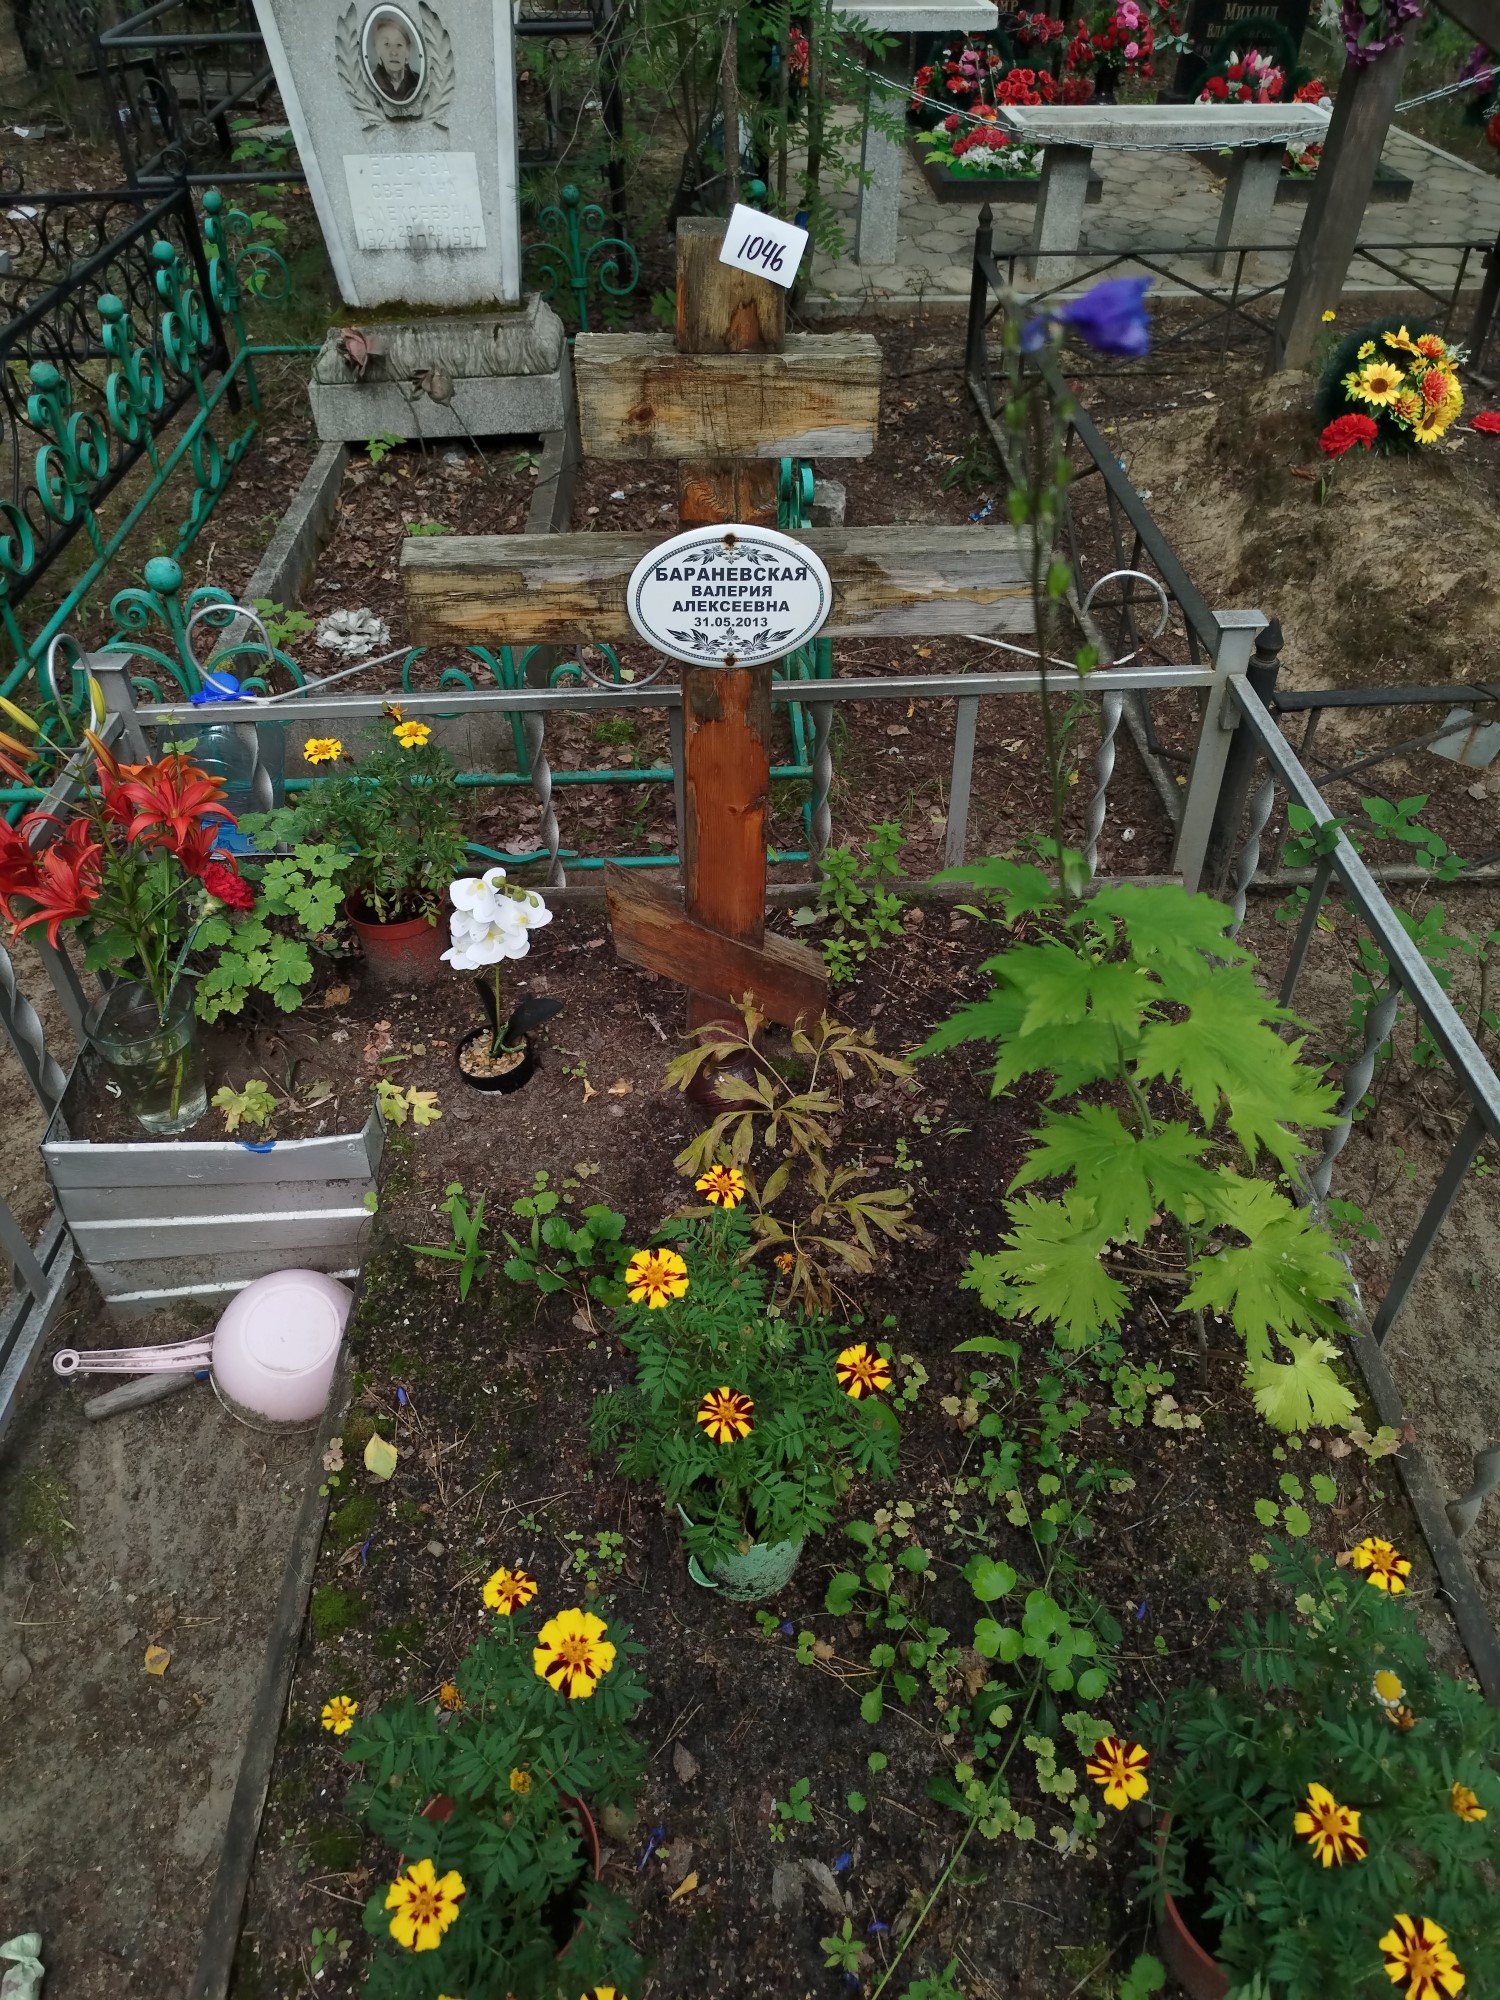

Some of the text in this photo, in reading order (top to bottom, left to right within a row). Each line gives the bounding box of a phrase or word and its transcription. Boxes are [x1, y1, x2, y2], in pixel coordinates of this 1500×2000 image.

[369, 155, 450, 176] ЕГОРОВА
[371, 181, 457, 199] СВЕТЛАНА
[737, 234, 787, 272] 1046
[655, 567, 807, 582] БАРАНЕВСКАЯ
[691, 585, 773, 597] ВАЛЕРИЯ
[672, 600, 790, 613] АЛЕКСЕЕВНА
[694, 617, 768, 628] 31.05.2013
